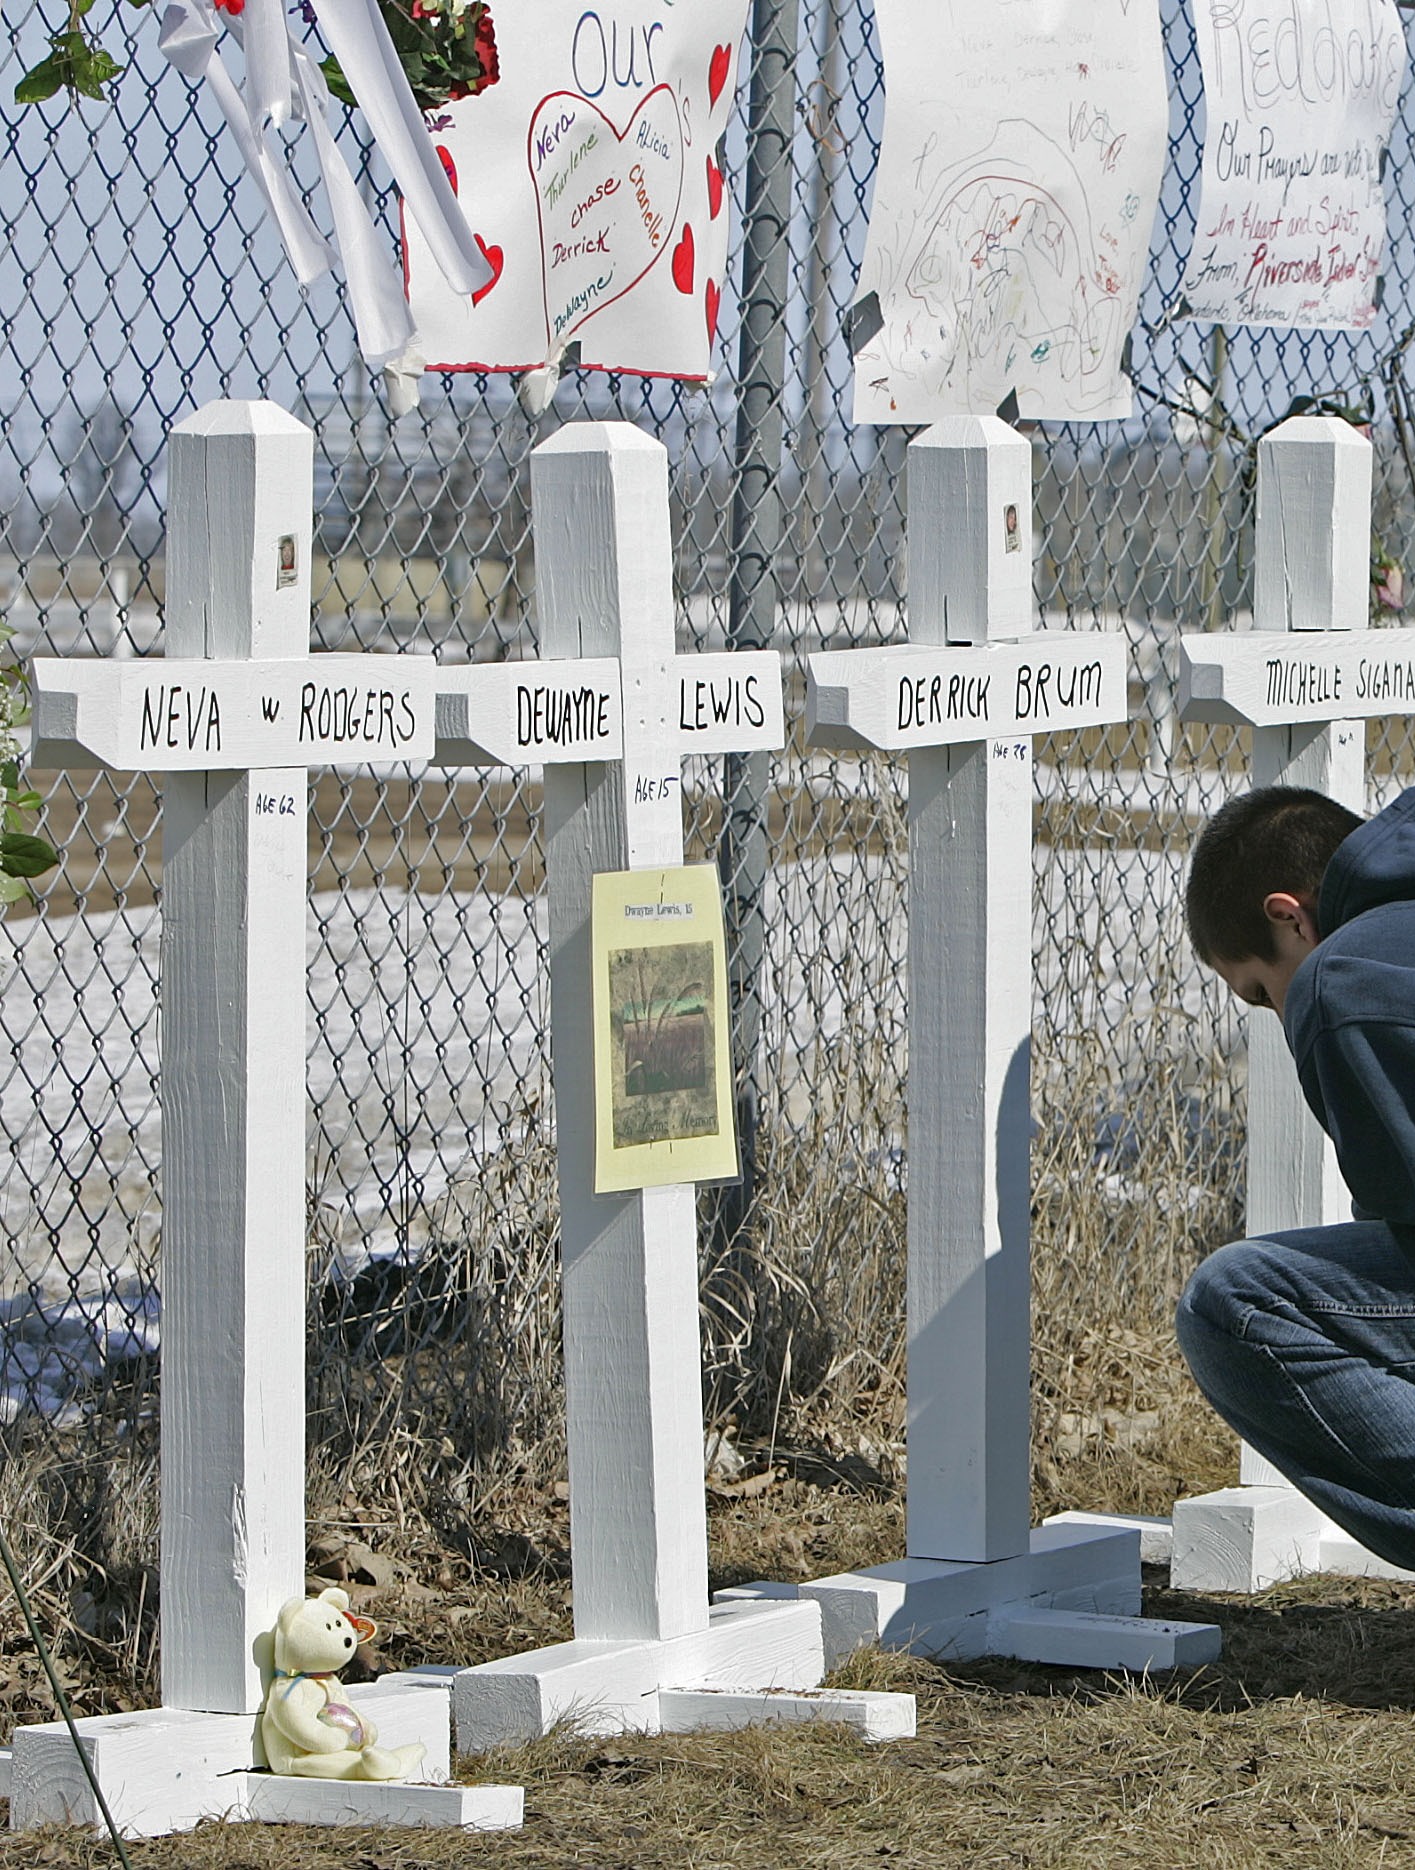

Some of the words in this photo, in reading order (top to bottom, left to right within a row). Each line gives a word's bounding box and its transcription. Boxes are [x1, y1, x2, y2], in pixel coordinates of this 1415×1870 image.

[572, 11, 664, 97] Our
[536, 111, 576, 172] Neva
[1217, 117, 1250, 181] Our
[629, 163, 663, 248] Chanelle
[1287, 204, 1312, 238] and
[551, 226, 610, 269] Derrick
[517, 685, 610, 747] DEWAYNE
[680, 676, 765, 731] LEWIS
[898, 674, 991, 731] DERRICK
[1015, 661, 1102, 720] BRUM
[1266, 658, 1342, 706] MICHELLE
[1356, 658, 1415, 701] SIGANA
[141, 685, 221, 752] NEVA
[299, 682, 416, 748] RODGERS
[255, 792, 277, 816] AGE
[279, 794, 296, 817] 62
[635, 775, 656, 802] AGE
[658, 776, 679, 801] 15
